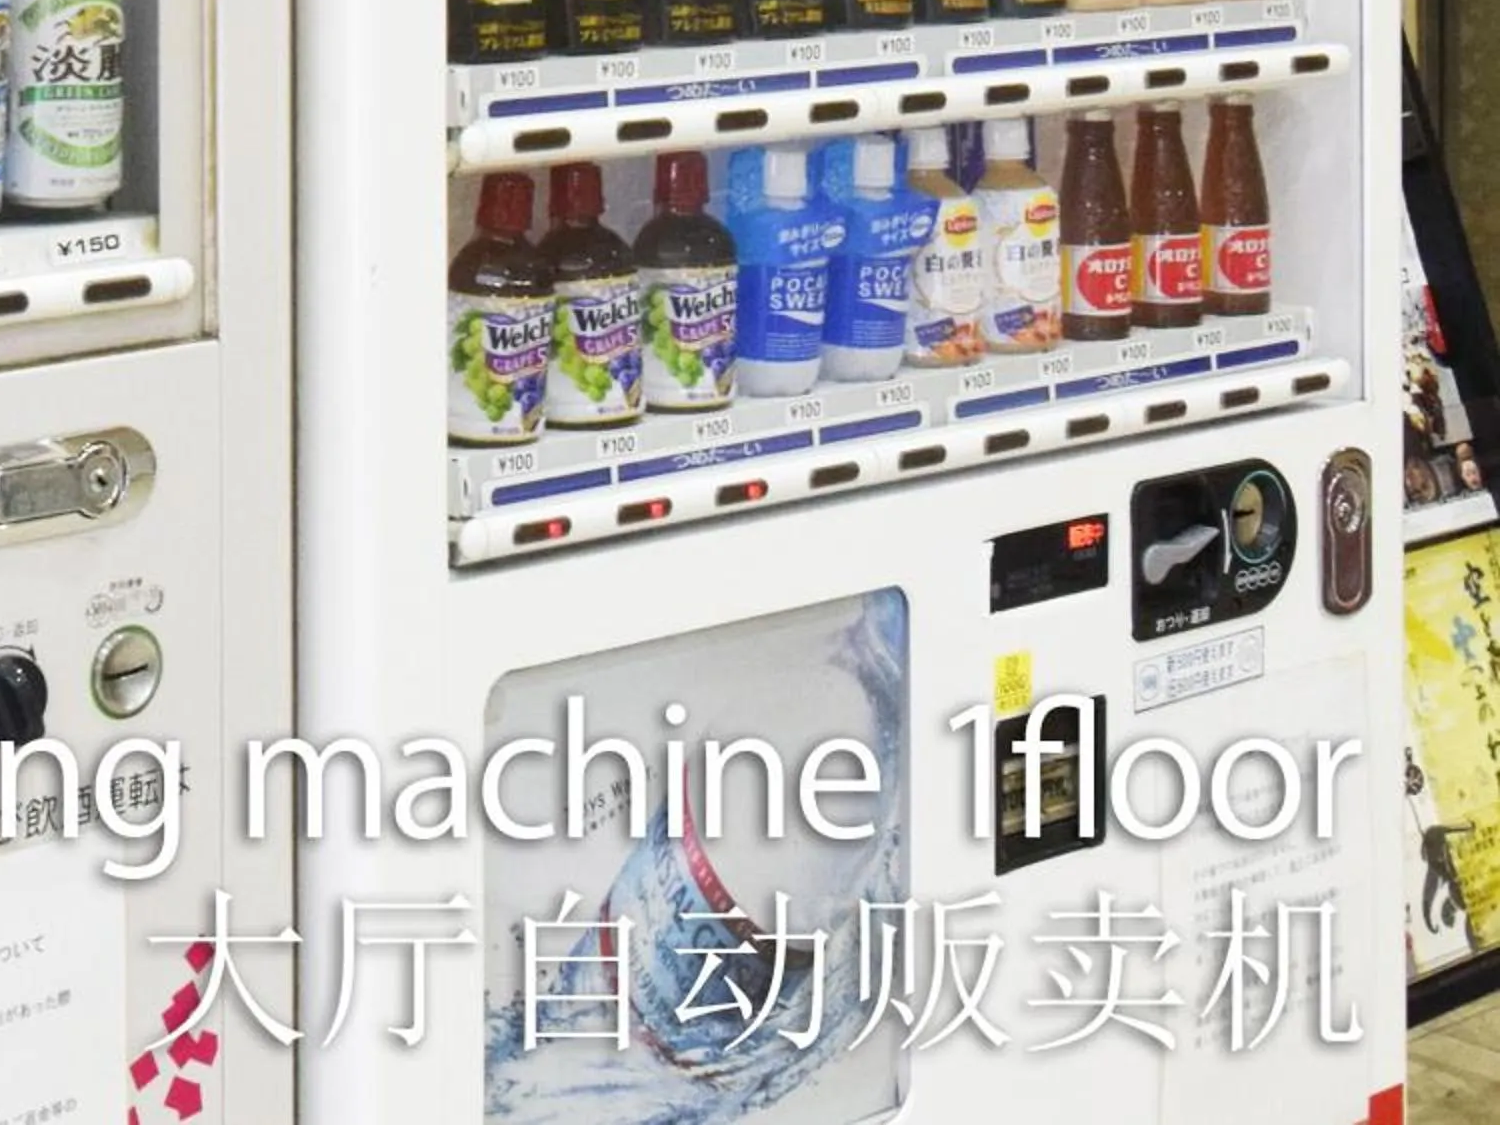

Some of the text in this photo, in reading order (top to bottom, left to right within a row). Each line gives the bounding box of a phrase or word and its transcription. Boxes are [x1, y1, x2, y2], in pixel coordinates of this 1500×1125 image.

[56, 232, 122, 257] ¥150
[859, 265, 905, 281] POC
[573, 296, 640, 332] Welch
[670, 286, 735, 319] Welch
[487, 312, 551, 350] Welch
